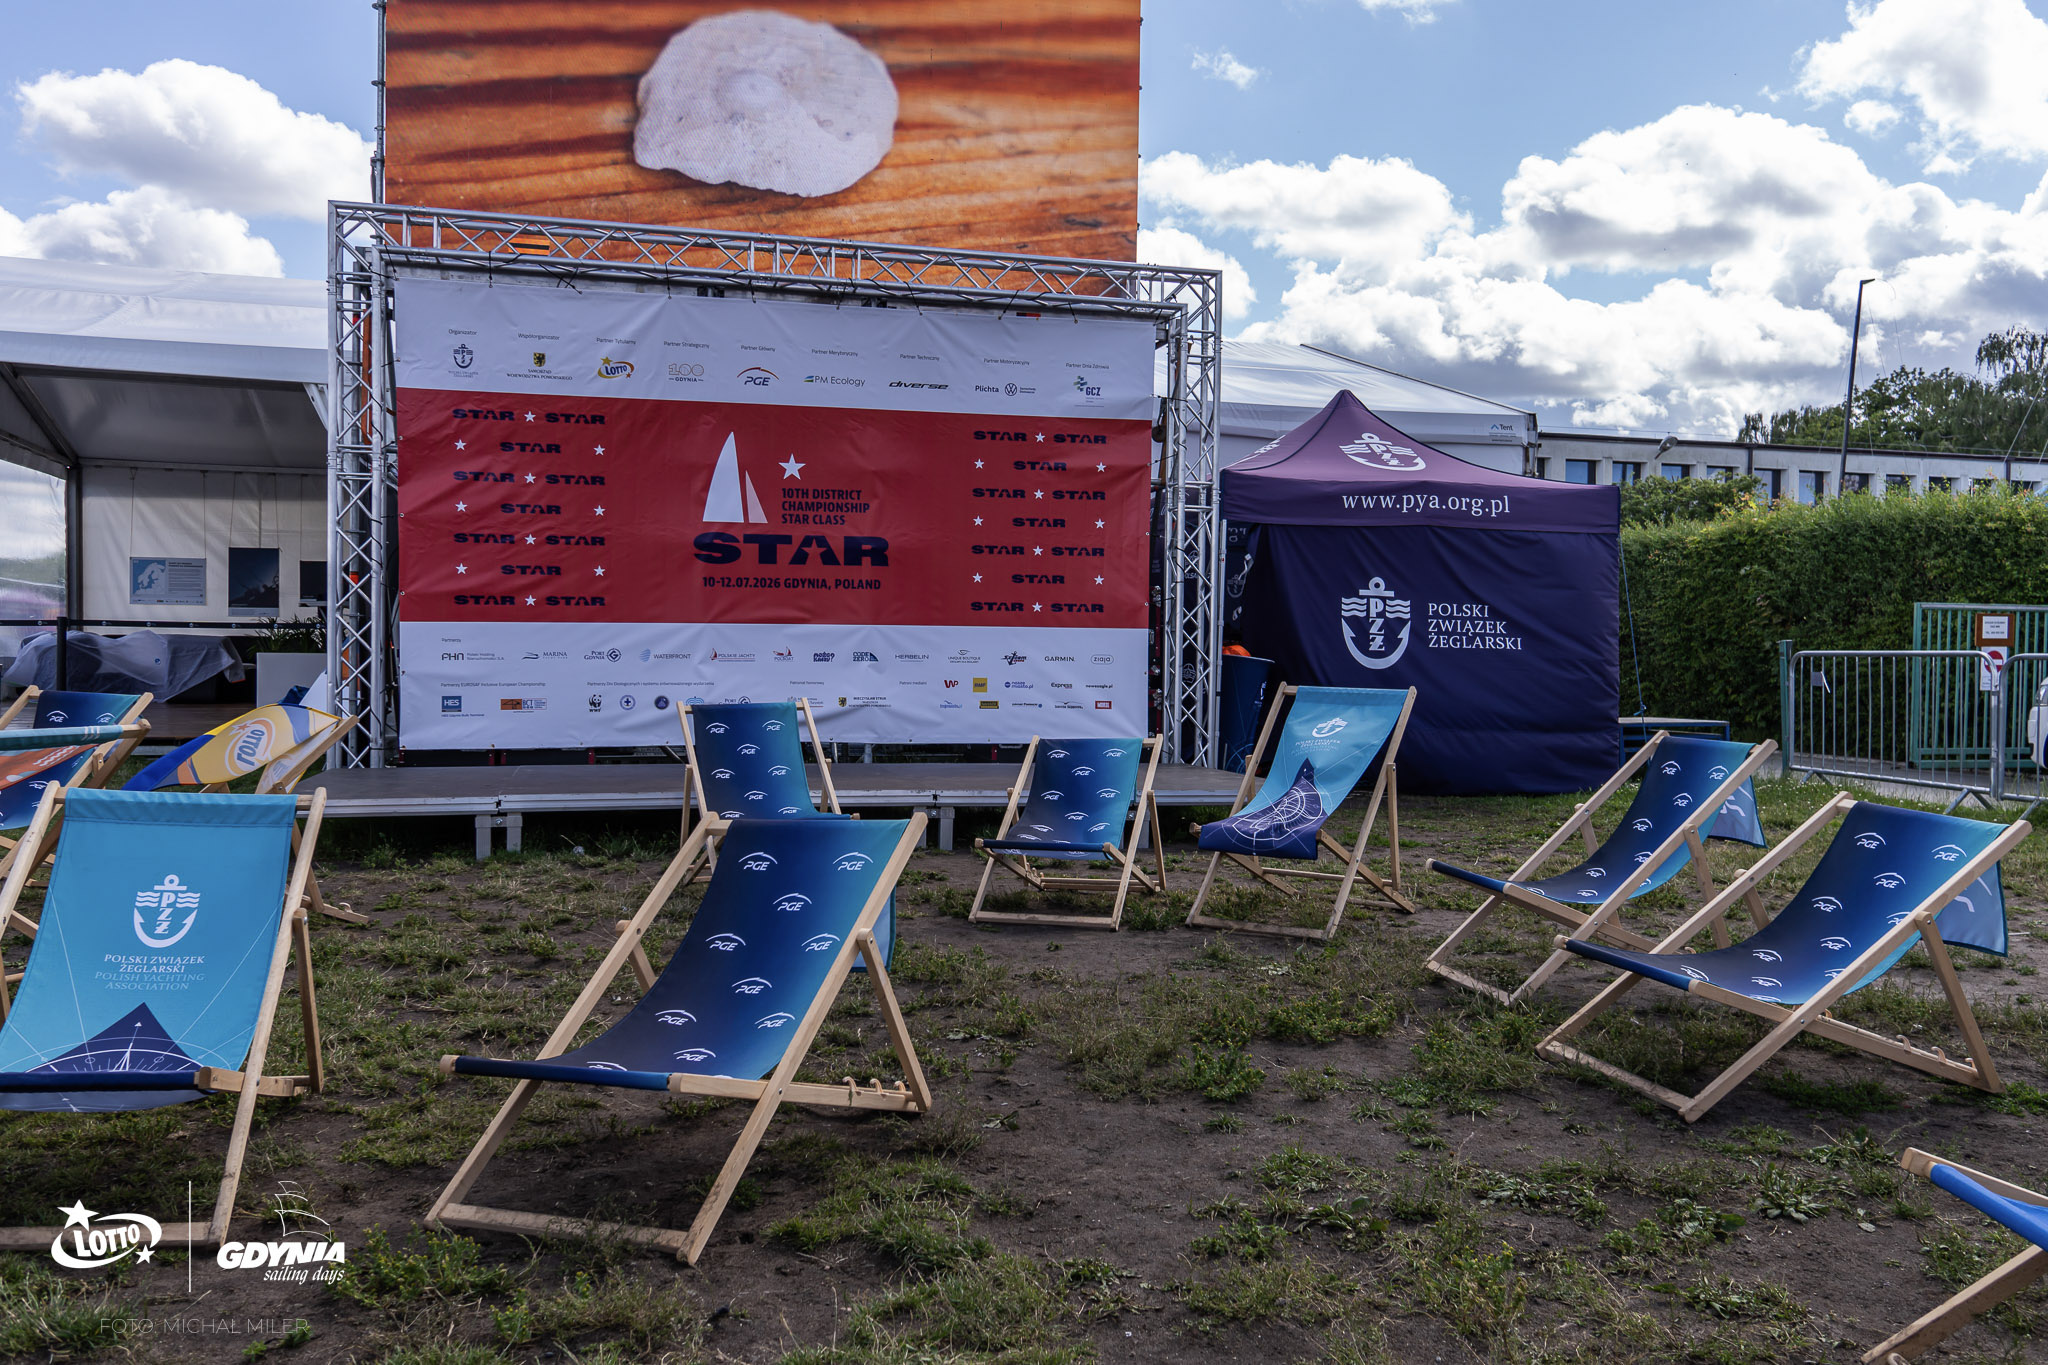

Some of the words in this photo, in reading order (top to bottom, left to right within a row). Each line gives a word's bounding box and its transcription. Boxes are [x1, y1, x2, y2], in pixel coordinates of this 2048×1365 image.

[448, 328, 477, 337] Organizator
[605, 365, 628, 376] LOTTO
[669, 364, 705, 377] 100
[744, 376, 771, 386] PGE
[815, 376, 829, 384] PM
[831, 376, 866, 388] Ecology
[889, 381, 949, 390] diverse
[975, 385, 1000, 393] Plichta
[1086, 386, 1101, 397] GCZ
[452, 408, 516, 421] STAR
[545, 412, 606, 425] STAR
[973, 430, 1028, 442] STAR
[1053, 433, 1107, 444] STAR
[500, 442, 561, 454] STAR
[1013, 460, 1067, 471] STAR
[453, 470, 515, 483] STAR
[545, 474, 606, 486] STAR
[782, 488, 809, 499] 10TH
[812, 489, 862, 500] DISTRICT
[972, 488, 1026, 499] STAR
[1052, 490, 1106, 501] STAR
[501, 503, 561, 515] STAR
[782, 501, 870, 513] CHAMPIONSHIP
[1342, 493, 1510, 517] www.pya.org.pl
[782, 514, 810, 525] STAR
[812, 515, 846, 526] CLASS
[1012, 517, 1066, 528] STAR
[453, 532, 516, 544] STAR
[545, 535, 606, 547] STAR
[693, 532, 889, 567] STAR
[971, 544, 1025, 556] STAR
[1051, 546, 1105, 557] STAR
[501, 564, 561, 576] STAR
[703, 577, 781, 588] 10-12.07.2026
[784, 578, 832, 590] GDYNIA,
[835, 579, 882, 590] POLAND
[1011, 573, 1065, 585] STAR
[454, 594, 516, 606] STAR
[545, 596, 606, 607] STAR
[970, 601, 1024, 612] STAR
[1050, 603, 1104, 613] STAR
[1428, 602, 1489, 618] POLSKI
[1428, 618, 1508, 635] ZWIĄZEK
[1428, 633, 1523, 651] ŻEGLARSKI
[944, 680, 959, 688] WP
[49, 715, 65, 723] PGE
[1856, 837, 1880, 850] PGE
[1933, 851, 1959, 862] PGE
[743, 861, 770, 871] PGE
[838, 861, 865, 871] PGE
[1875, 878, 1899, 889] PGE
[777, 902, 805, 911] PGE
[1813, 901, 1834, 912] PGE
[709, 941, 738, 951] PGE
[804, 940, 833, 951] PGE
[1821, 940, 1844, 950] PGE
[104, 954, 148, 965] POLSKI
[151, 955, 205, 968] ZWIĄZEK
[1753, 952, 1777, 962] PGE
[119, 962, 186, 974] ŻEGLARSKI
[95, 970, 140, 981] POLISH
[143, 972, 205, 983] YACHTING
[105, 981, 190, 992] ASSOCIATION
[735, 985, 764, 994] PGE
[658, 1015, 688, 1026] PGE
[758, 1018, 788, 1029] PGE
[676, 1053, 708, 1062] PGE
